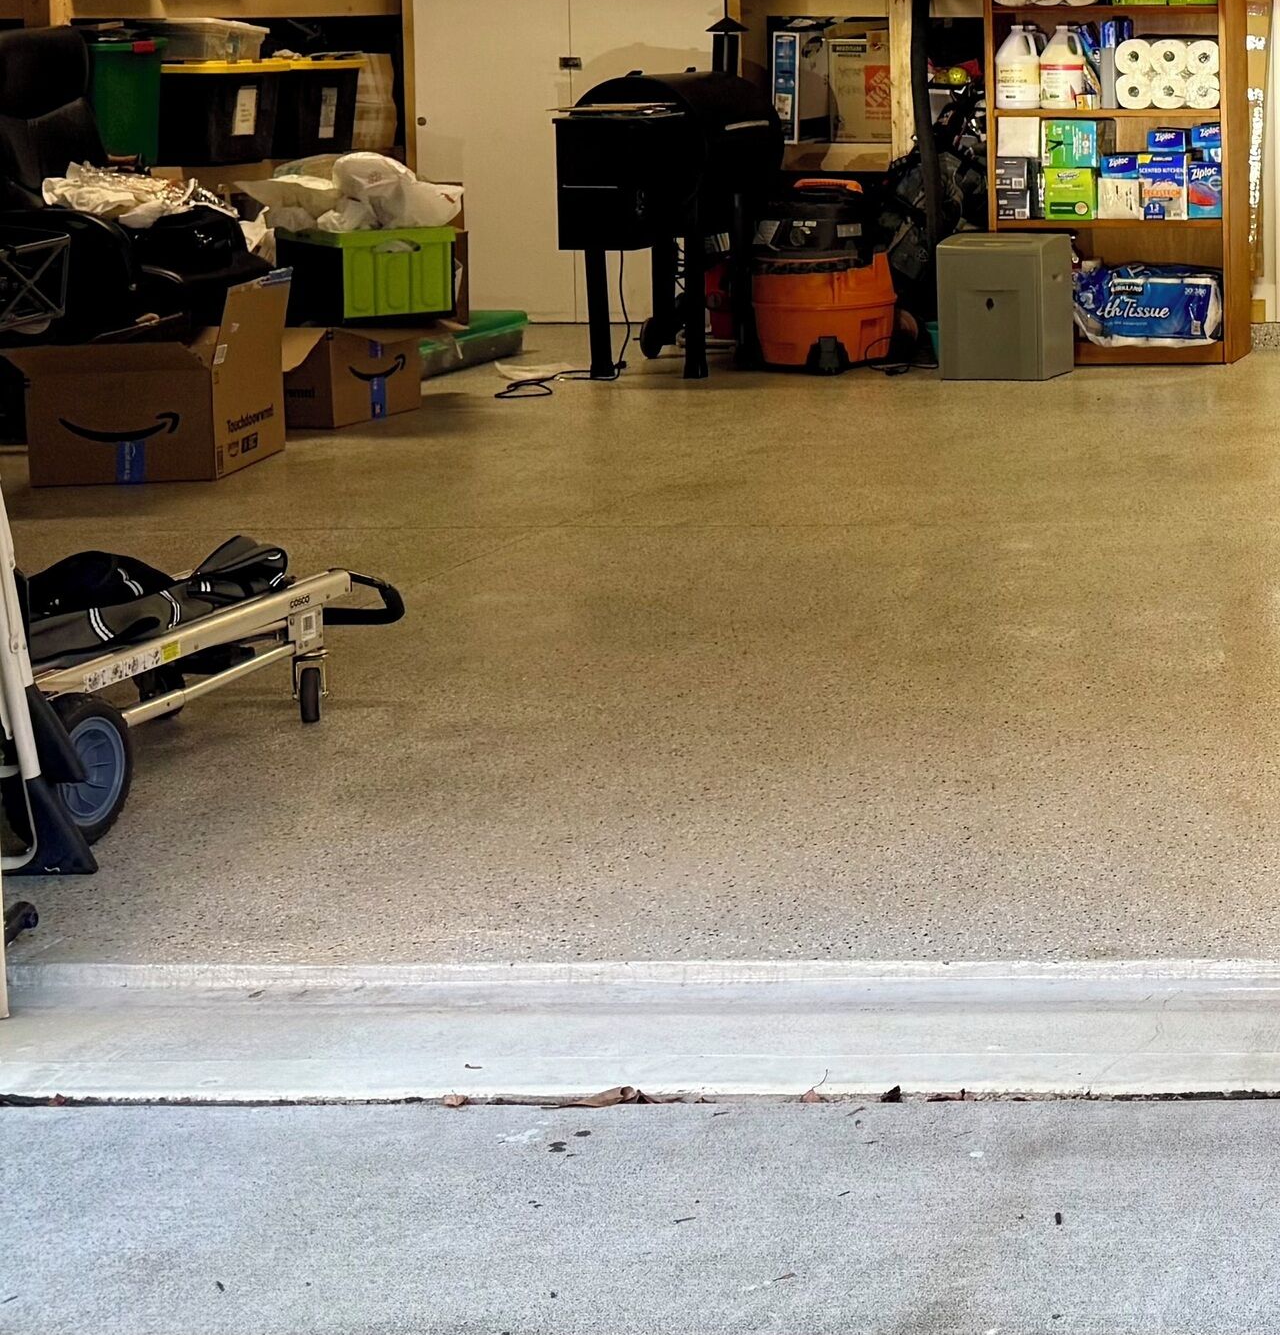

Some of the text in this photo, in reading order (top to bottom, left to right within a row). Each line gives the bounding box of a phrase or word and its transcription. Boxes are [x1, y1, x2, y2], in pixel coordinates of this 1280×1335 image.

[1154, 132, 1176, 142] Ziploc
[1199, 126, 1220, 138] Ziploc
[1108, 157, 1129, 167] Ziploc
[1190, 166, 1218, 180] Ziploc
[1124, 298, 1170, 319] Tissue
